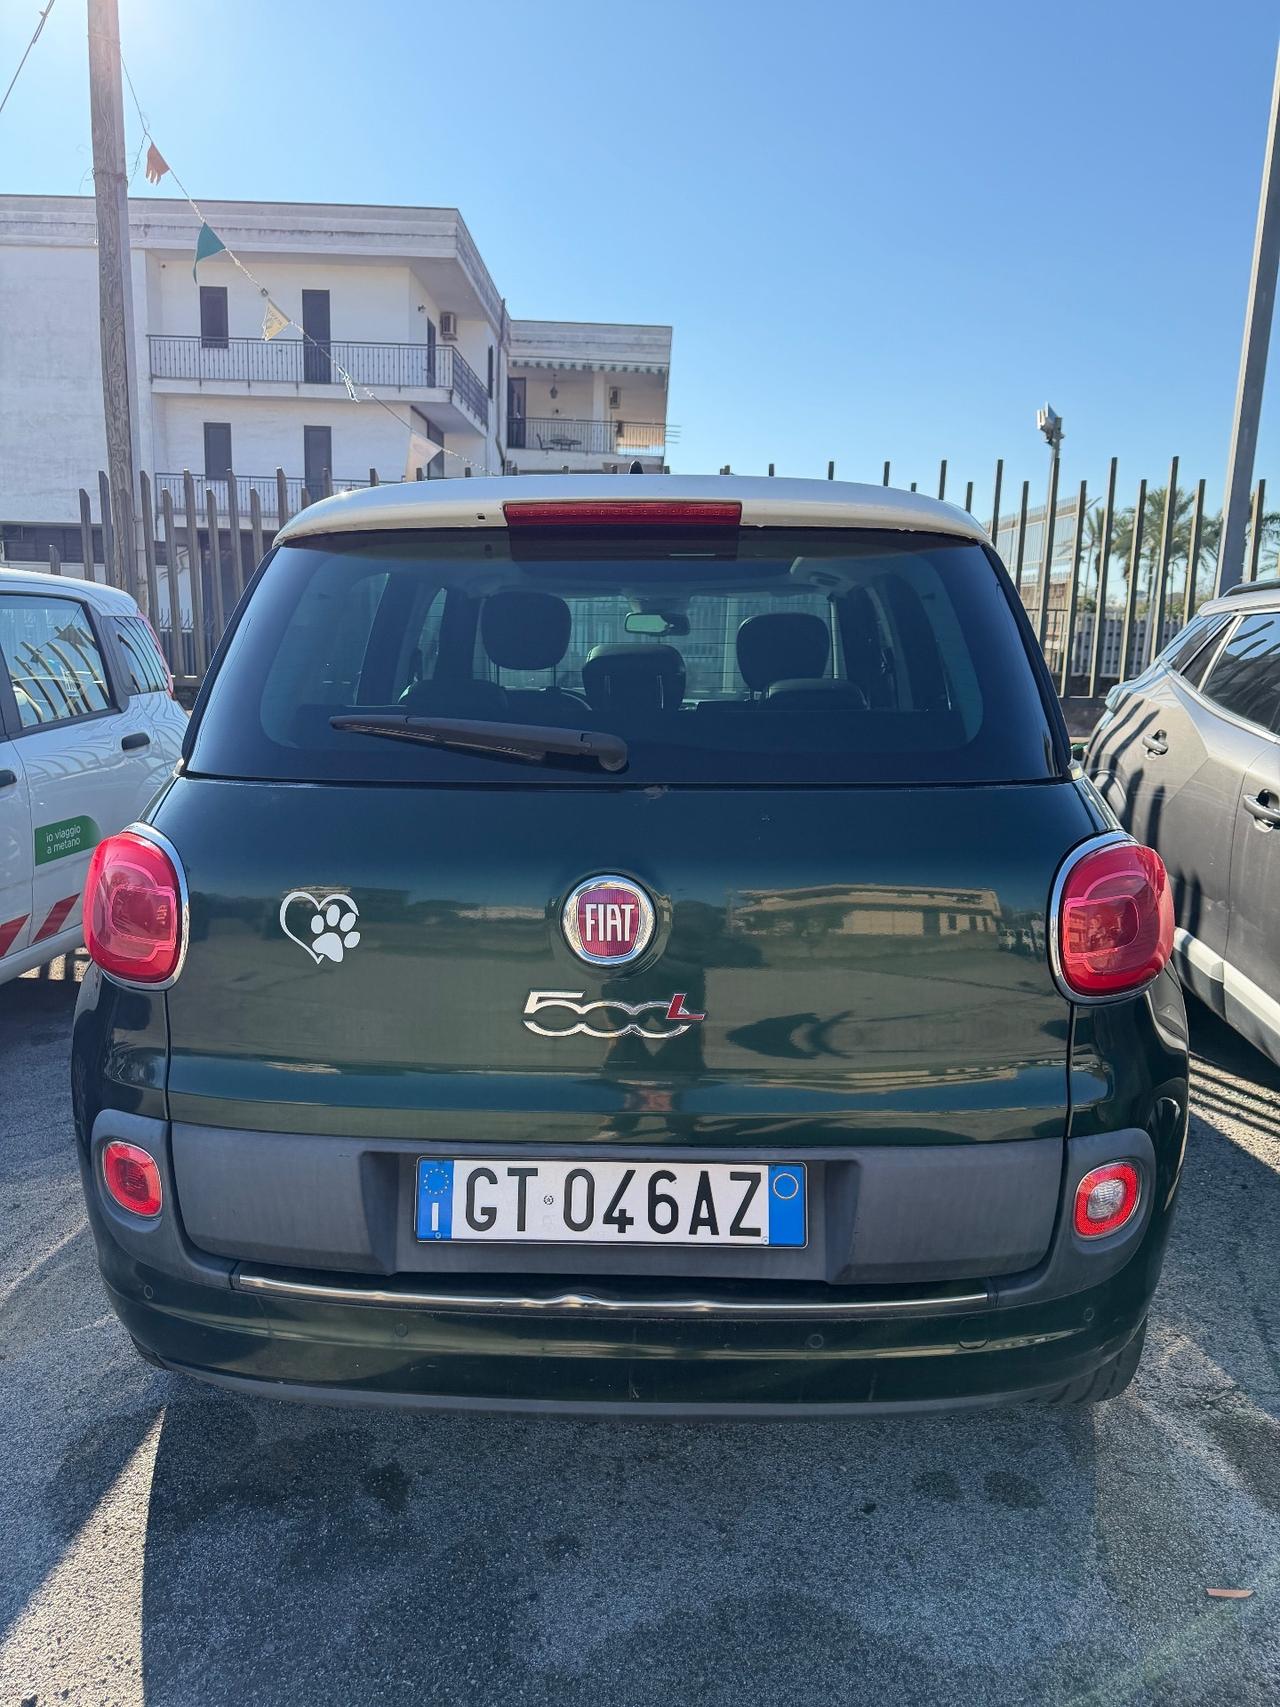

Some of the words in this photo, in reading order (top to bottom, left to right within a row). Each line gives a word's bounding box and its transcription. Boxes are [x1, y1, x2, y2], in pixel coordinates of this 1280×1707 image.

[46, 832, 54, 843] io
[55, 824, 81, 839] viaggio
[46, 846, 52, 855] a
[53, 837, 81, 852] metano
[585, 903, 635, 942] FIAT
[466, 1167, 539, 1232] GT
[563, 1168, 762, 1237] 046AZ
